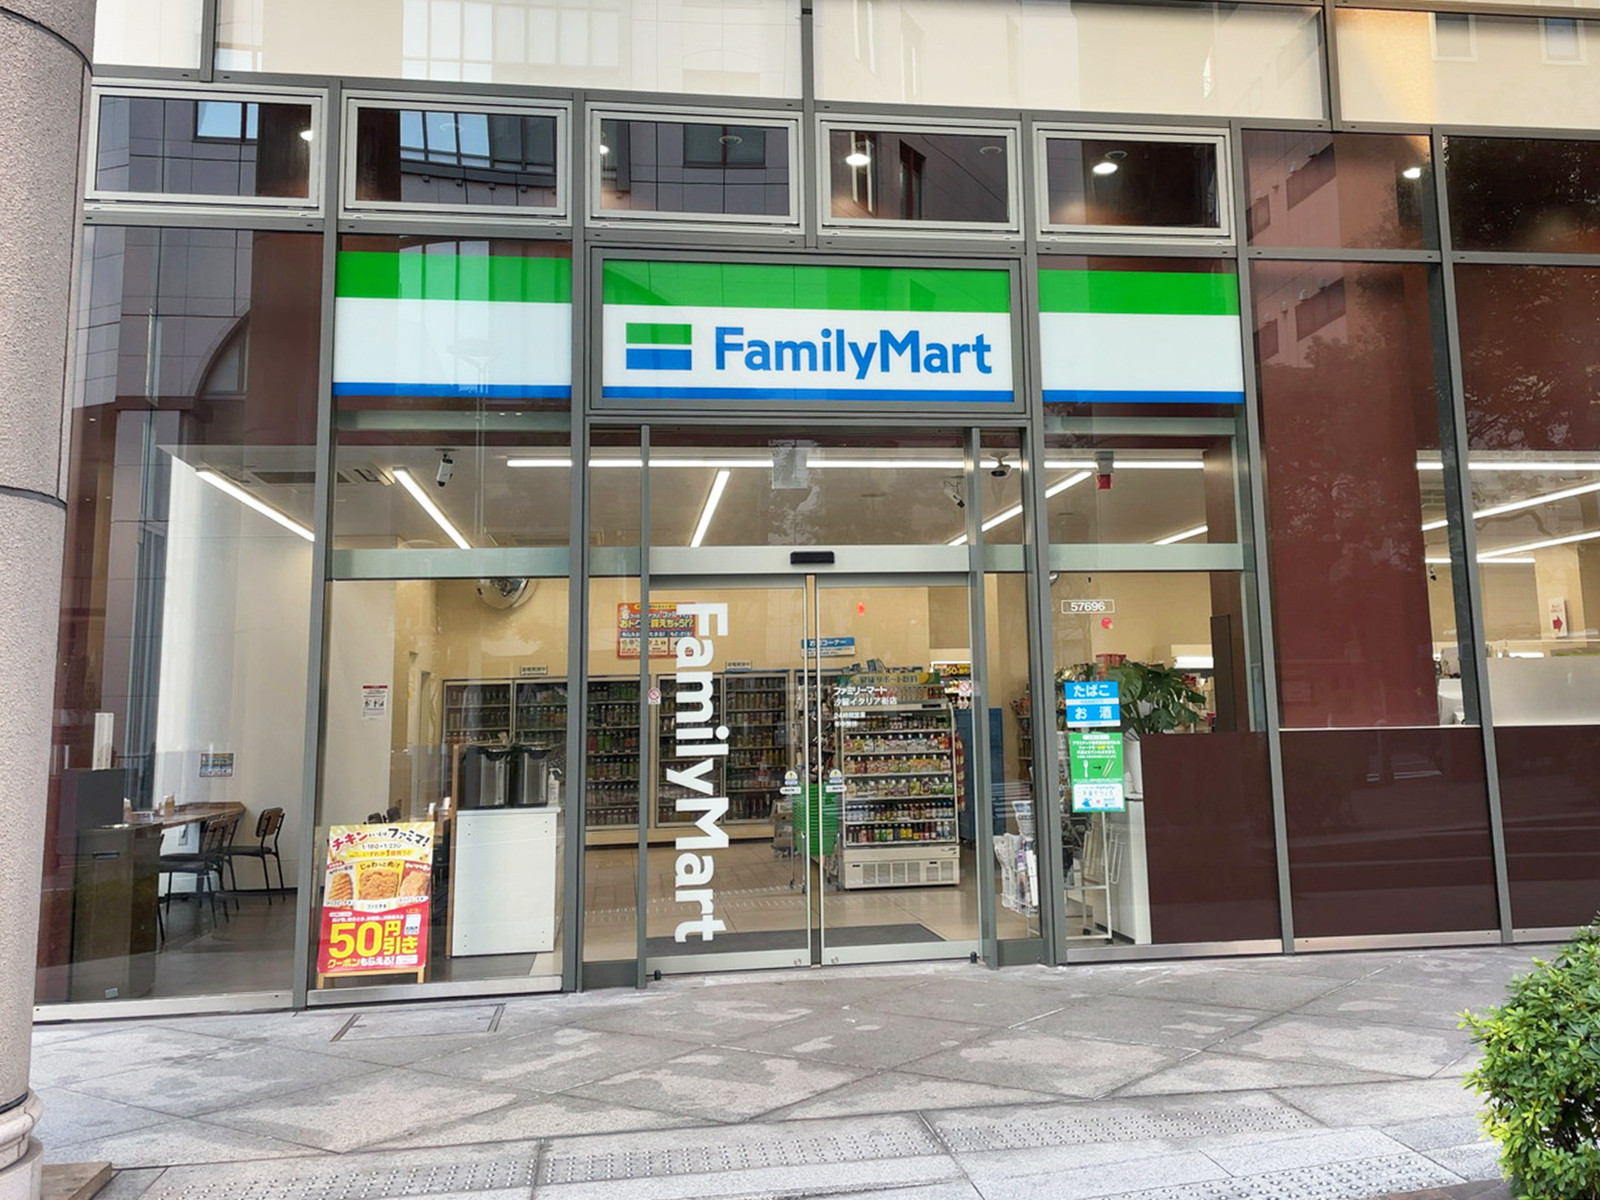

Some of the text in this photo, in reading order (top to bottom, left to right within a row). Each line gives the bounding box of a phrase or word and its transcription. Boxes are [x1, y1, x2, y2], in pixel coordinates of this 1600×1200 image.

[715, 326, 993, 380] FamilyMart
[1071, 602, 1105, 611] 57696
[833, 686, 888, 695] ファミリーマート
[1074, 684, 1110, 697] たばこ
[666, 603, 729, 942] FamilyMart
